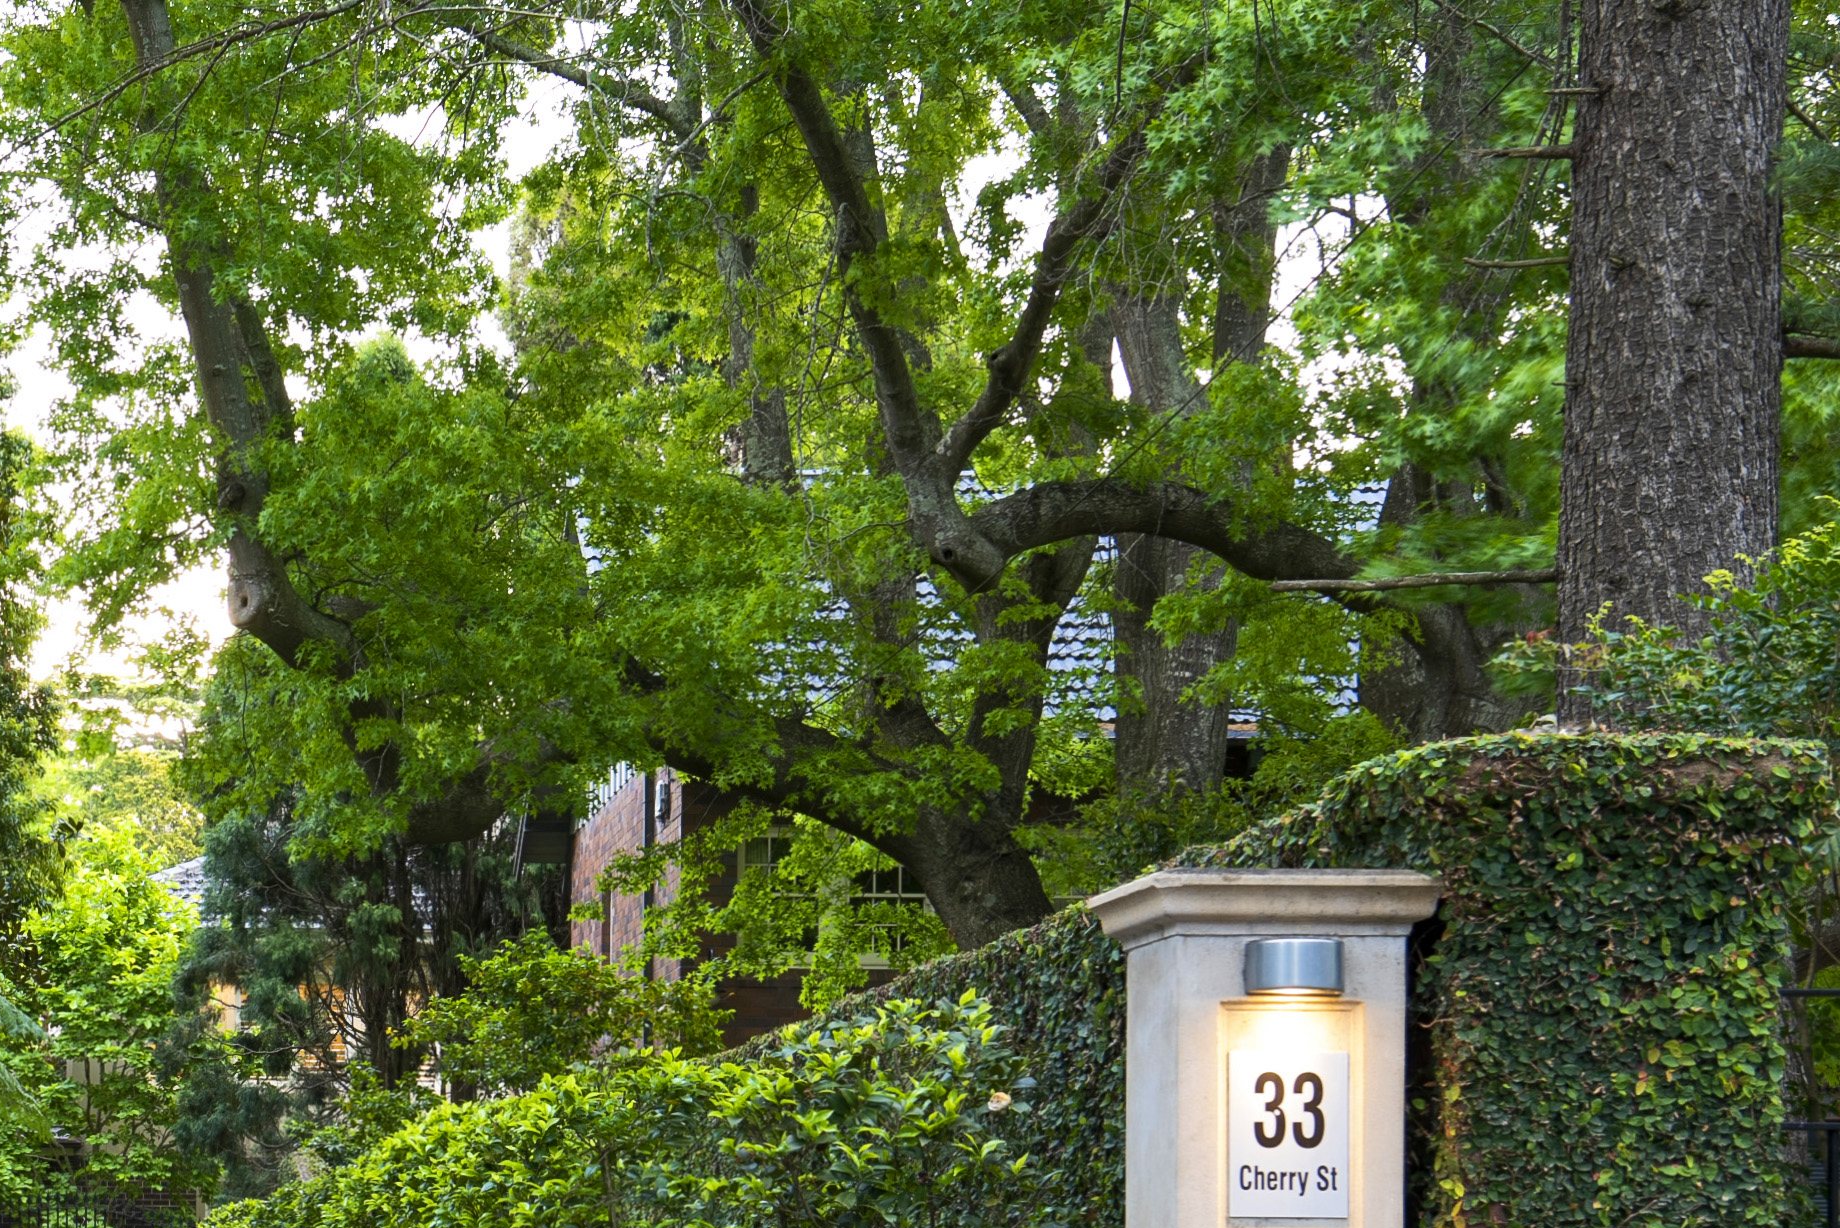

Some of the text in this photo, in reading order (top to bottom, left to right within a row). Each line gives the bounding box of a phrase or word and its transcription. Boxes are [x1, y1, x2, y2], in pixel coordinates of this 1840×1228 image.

[1253, 1071, 1326, 1149] 33
[1239, 1164, 1338, 1197] Cherry St
